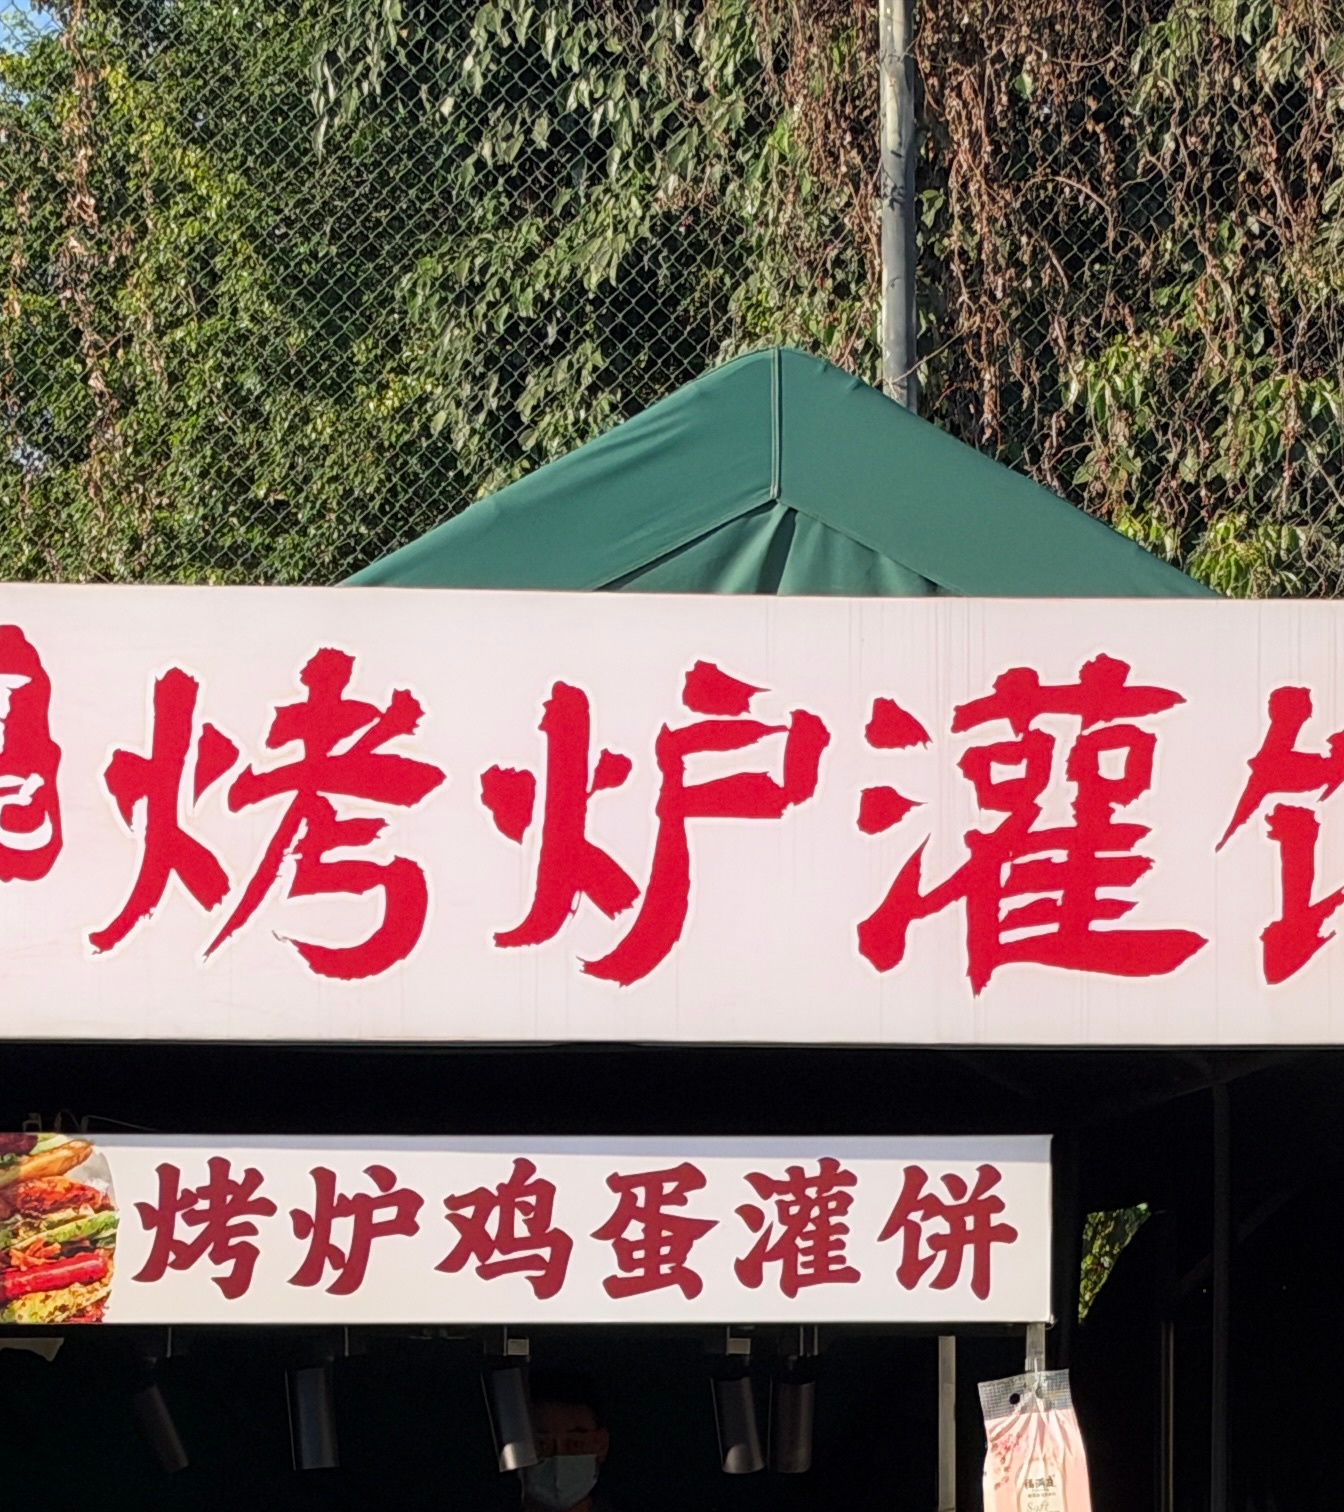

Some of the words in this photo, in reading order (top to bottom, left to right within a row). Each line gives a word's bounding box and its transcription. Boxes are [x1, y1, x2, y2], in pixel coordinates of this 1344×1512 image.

[132, 1156, 1019, 1301] 烤炉鸡蛋灌饼
